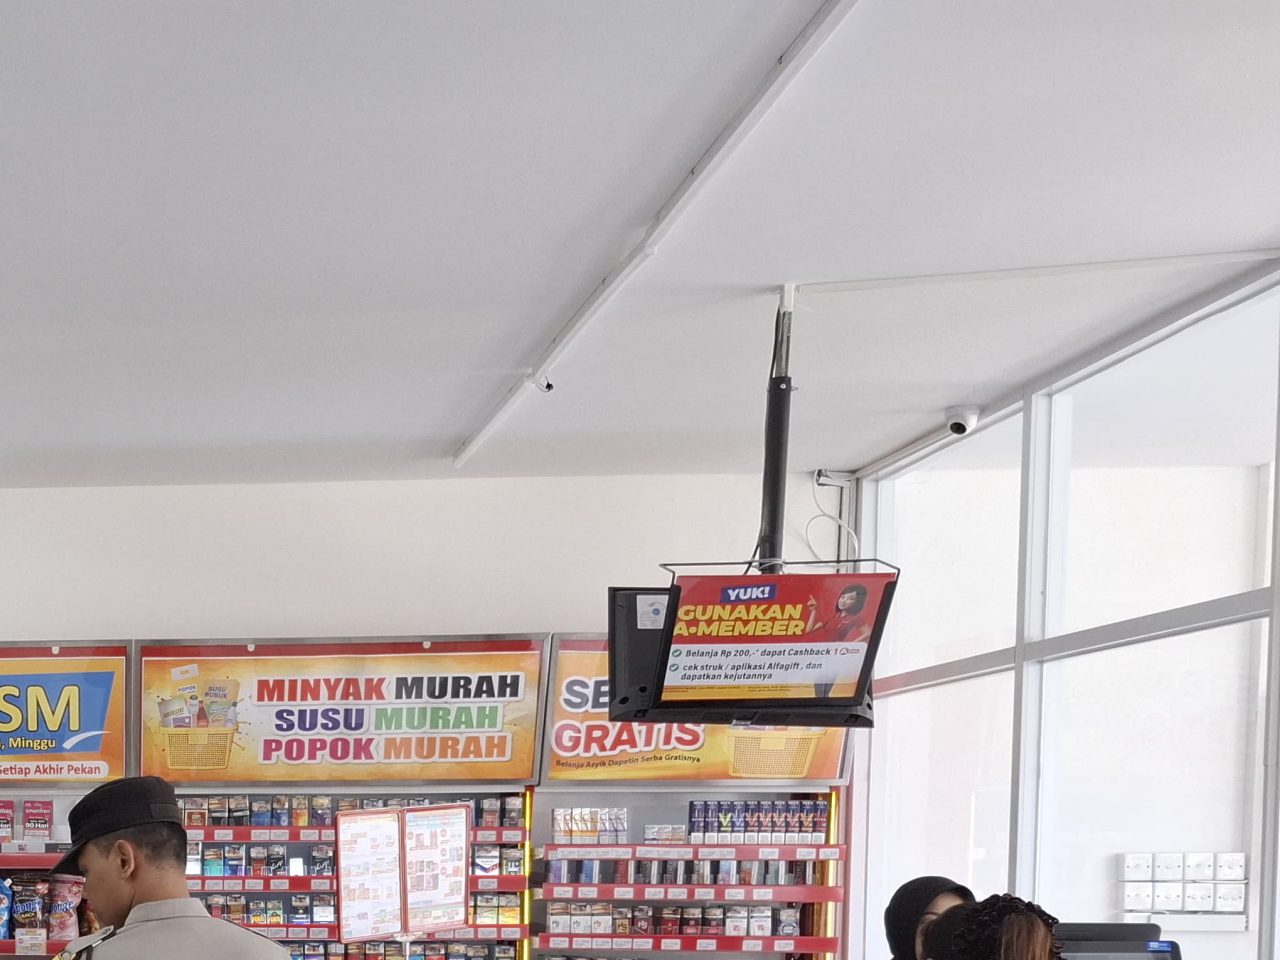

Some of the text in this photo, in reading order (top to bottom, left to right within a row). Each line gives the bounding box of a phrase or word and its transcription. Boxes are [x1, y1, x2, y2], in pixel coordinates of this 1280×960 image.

[727, 586, 770, 600] YUK!
[677, 604, 803, 621] GUNAKAN
[685, 649, 718, 658] Belanja
[721, 650, 732, 659] Rp
[760, 649, 786, 658] dapat
[787, 648, 831, 657] Cashback
[700, 663, 724, 671] struk
[730, 663, 766, 673] aplikasi
[805, 661, 822, 670] dan
[680, 672, 772, 681] dapatkan kejutannya
[177, 684, 197, 693] POPOK
[207, 685, 227, 693] SUSU
[256, 675, 520, 702] MINYAK MURAH
[275, 706, 499, 732] SUSU MURAH
[9, 736, 56, 751] Minggu
[554, 722, 702, 752] GRATIS
[262, 735, 507, 761] POPOK MURAH
[556, 753, 701, 769] Belanja Asyik Dapetin Serba Gratisnya
[33, 764, 64, 775] Akhir
[67, 764, 101, 775] Pekan
